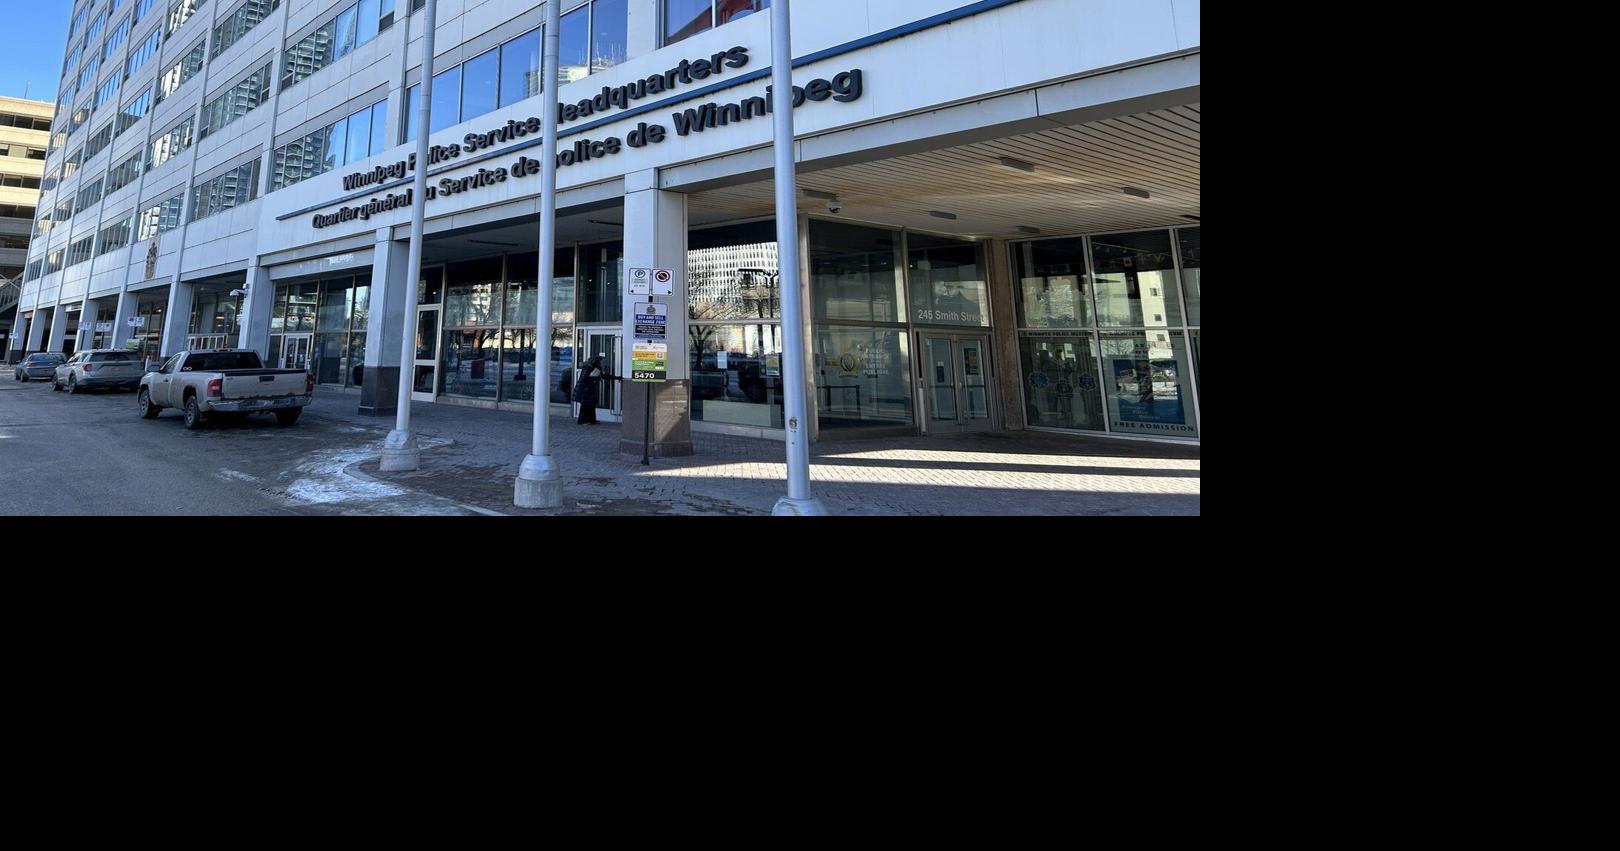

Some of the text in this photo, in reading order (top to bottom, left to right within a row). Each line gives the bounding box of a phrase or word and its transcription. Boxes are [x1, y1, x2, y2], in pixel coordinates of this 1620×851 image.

[312, 206, 361, 229] Quartier
[359, 188, 413, 220] général
[439, 167, 508, 197] Service
[511, 156, 540, 178] de
[556, 136, 622, 169] olice
[626, 122, 666, 148] de
[343, 160, 407, 191] Winnipeg
[408, 144, 461, 171] Plice
[463, 117, 541, 153] Service
[918, 309, 933, 320] 245
[935, 310, 960, 321] Smith
[1114, 421, 1195, 432] FREE ADMISSION
